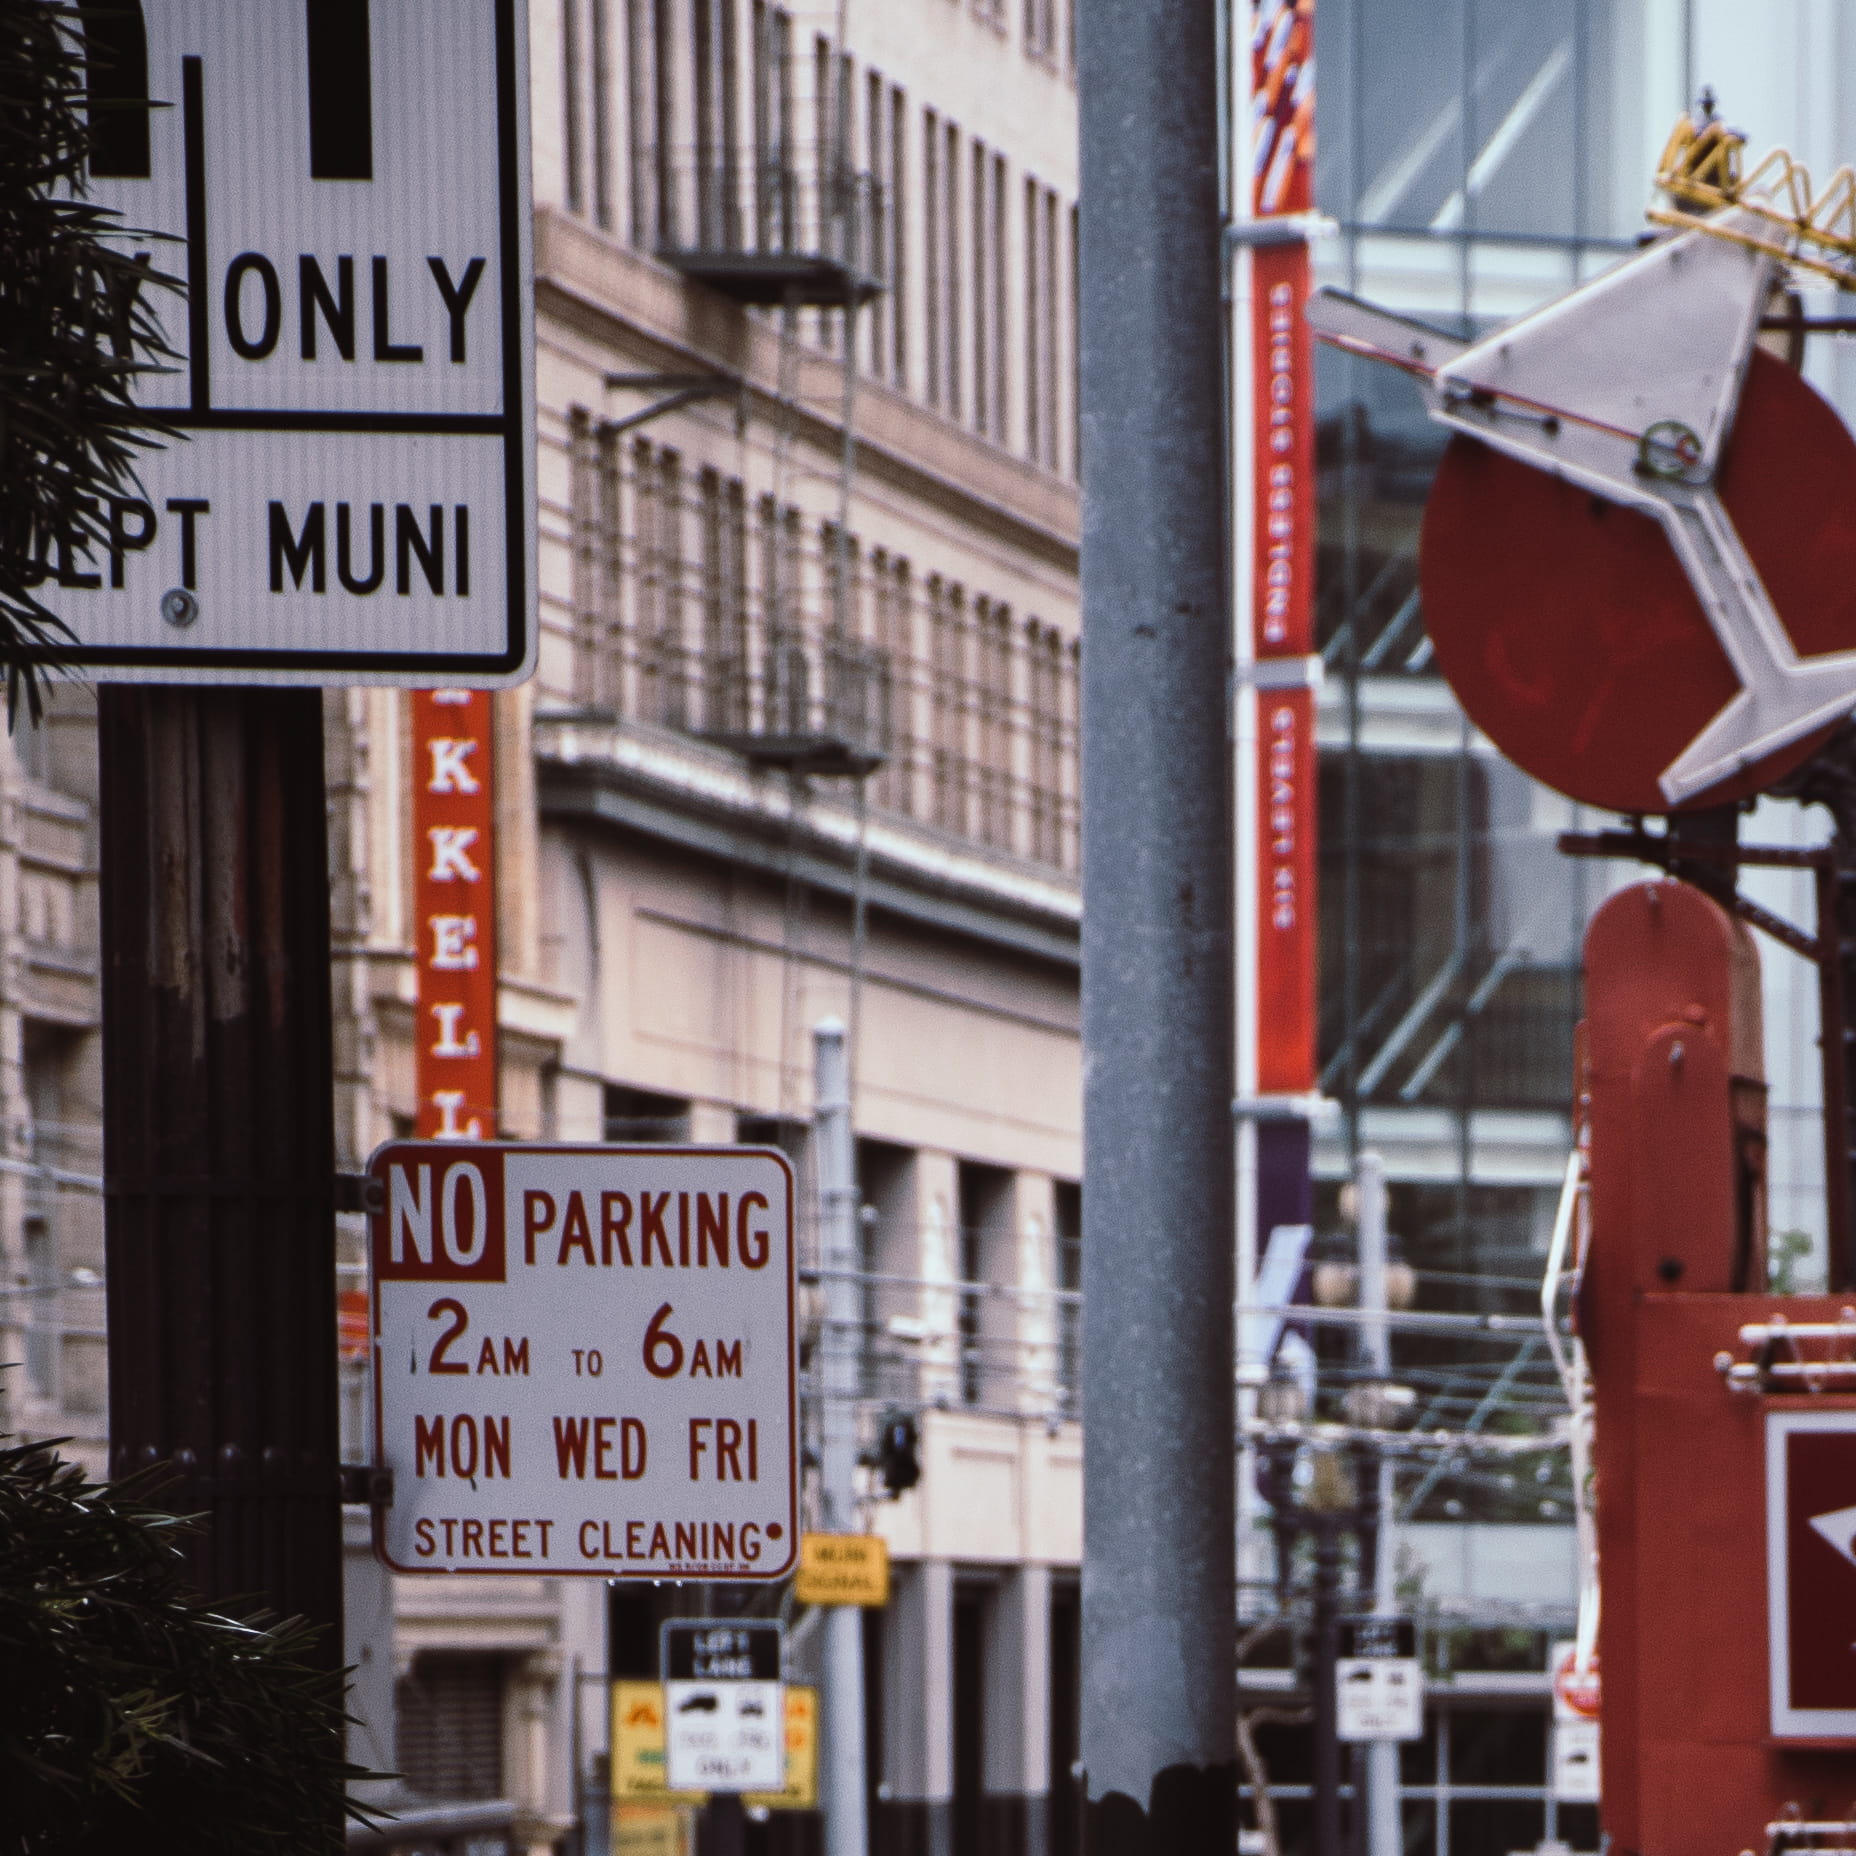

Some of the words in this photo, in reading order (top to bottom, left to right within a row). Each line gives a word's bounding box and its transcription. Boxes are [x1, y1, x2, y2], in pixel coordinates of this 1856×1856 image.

[223, 251, 486, 364] ONLY
[267, 500, 469, 597] MUNI
[427, 691, 482, 1142] KKELL
[389, 1161, 488, 1267] NO
[523, 1190, 770, 1269] PARKING
[427, 1299, 530, 1375] 2AM
[573, 1349, 602, 1377] TO
[642, 1302, 743, 1378] 6AM
[415, 1414, 511, 1478] MON
[554, 1417, 647, 1479] WED
[690, 1419, 757, 1481] FRI
[415, 1519, 554, 1558] STREET
[579, 1521, 761, 1562] CLEANING
